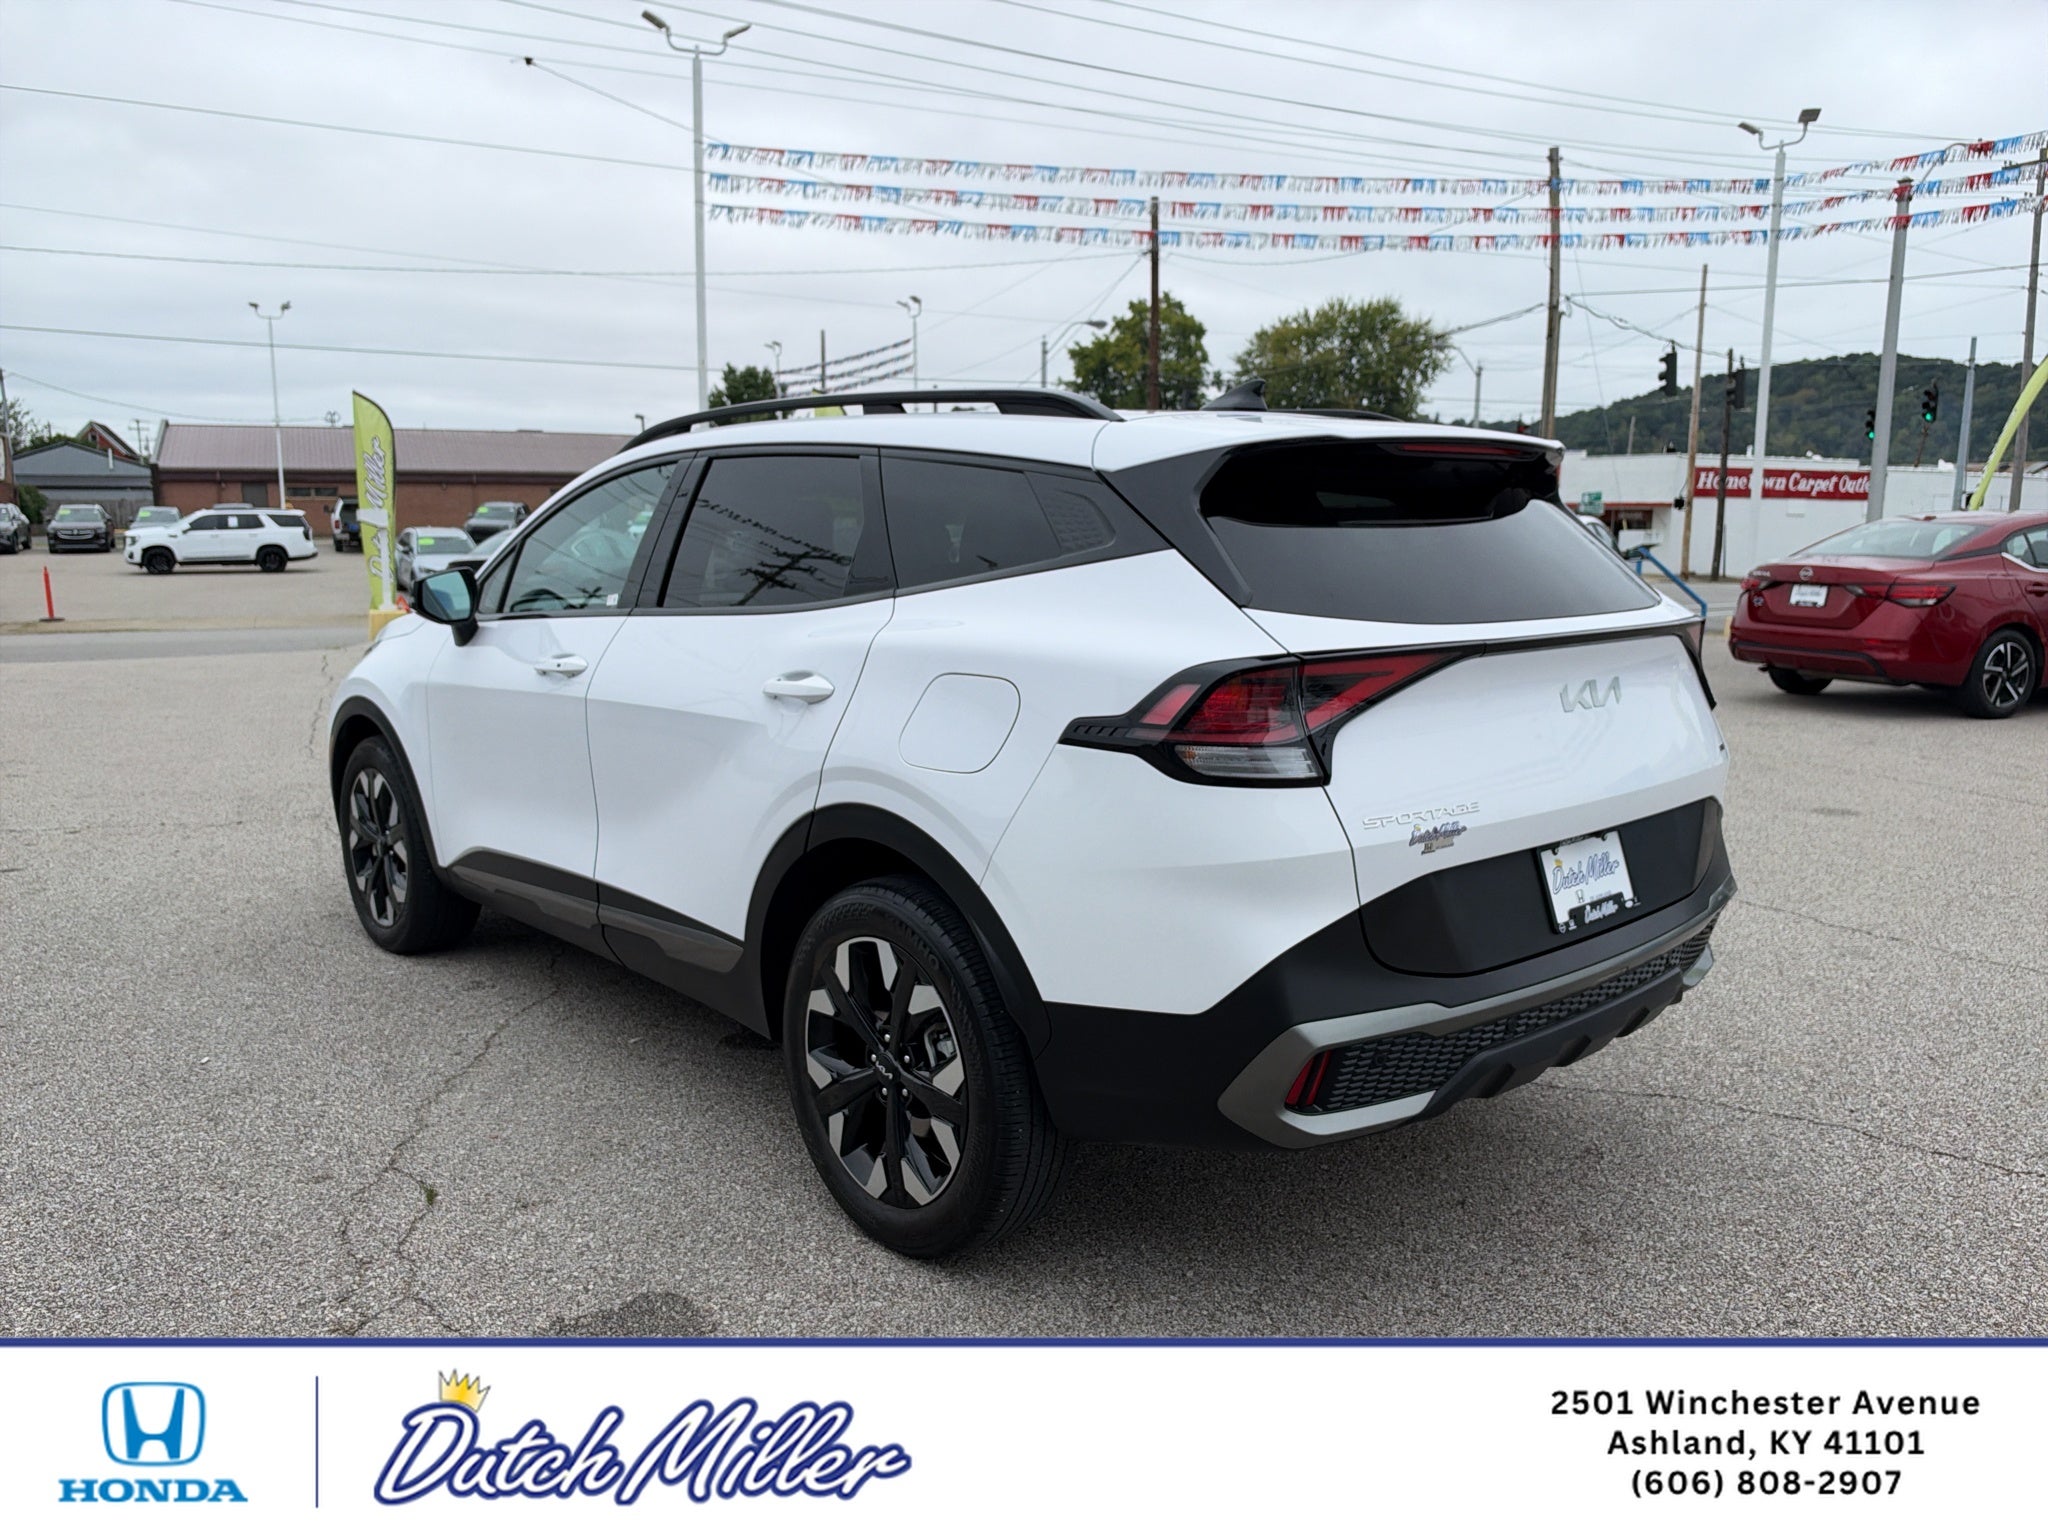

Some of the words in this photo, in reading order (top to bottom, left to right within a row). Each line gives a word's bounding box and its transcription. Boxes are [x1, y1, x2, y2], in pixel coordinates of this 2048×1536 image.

[1788, 472, 1839, 497] Carpet
[1838, 474, 1870, 494] Outle
[1362, 801, 1481, 830] SPORTAGE
[1552, 861, 1587, 895] Dutch
[1585, 851, 1620, 886] Miller
